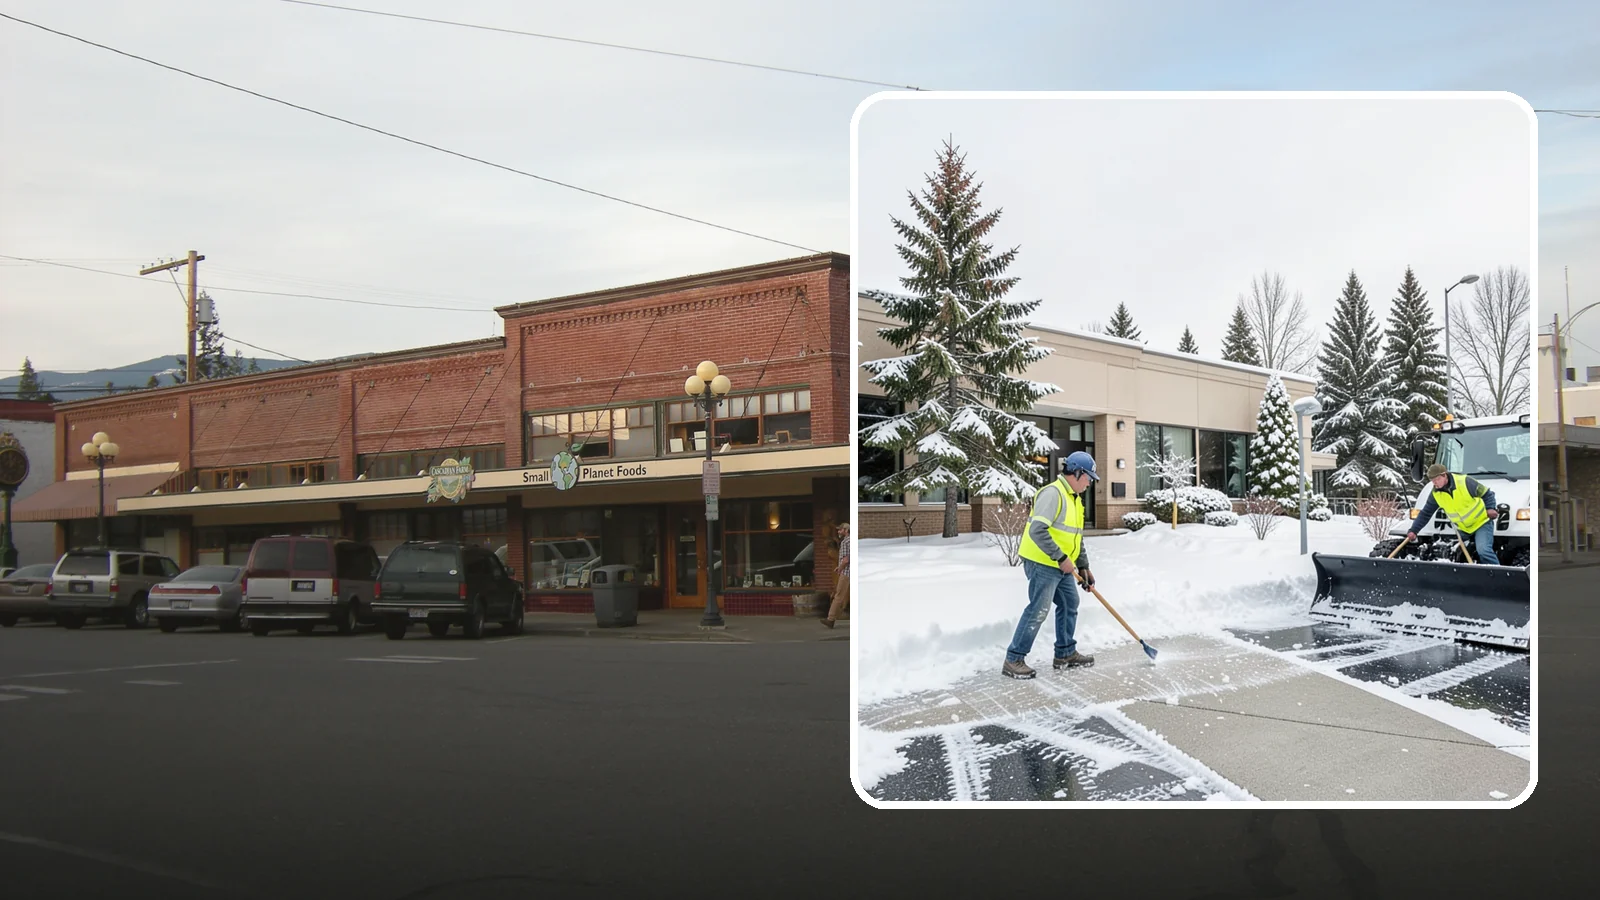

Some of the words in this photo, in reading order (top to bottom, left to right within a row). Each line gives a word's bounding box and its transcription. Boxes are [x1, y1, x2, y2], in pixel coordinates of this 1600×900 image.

[523, 470, 548, 482] Small
[583, 468, 614, 479] Planet
[617, 464, 646, 476] Foods
